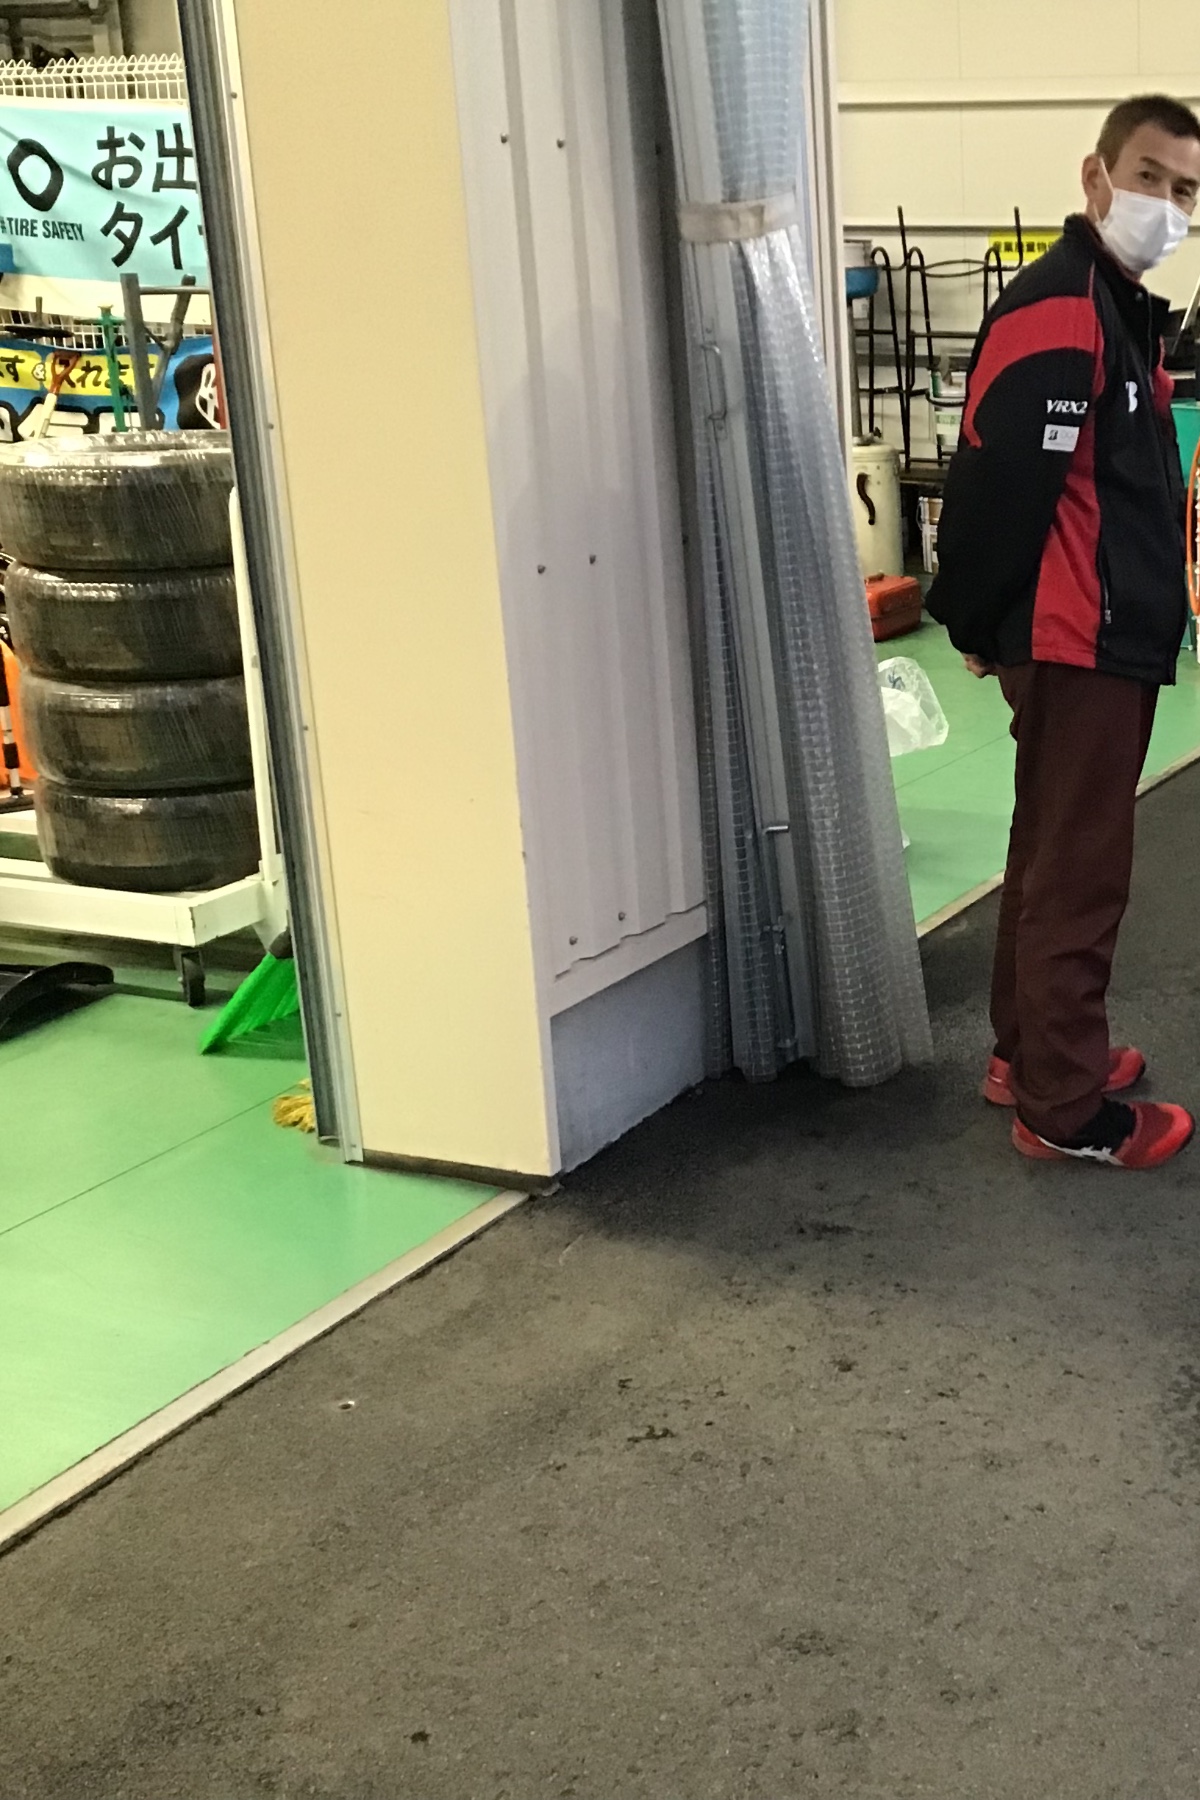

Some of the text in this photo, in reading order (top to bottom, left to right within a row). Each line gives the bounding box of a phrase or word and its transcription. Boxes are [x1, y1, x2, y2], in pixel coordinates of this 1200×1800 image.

[42, 220, 85, 241] SAFETY
[100, 201, 204, 271] タイ
[1046, 399, 1088, 414] VRX2
